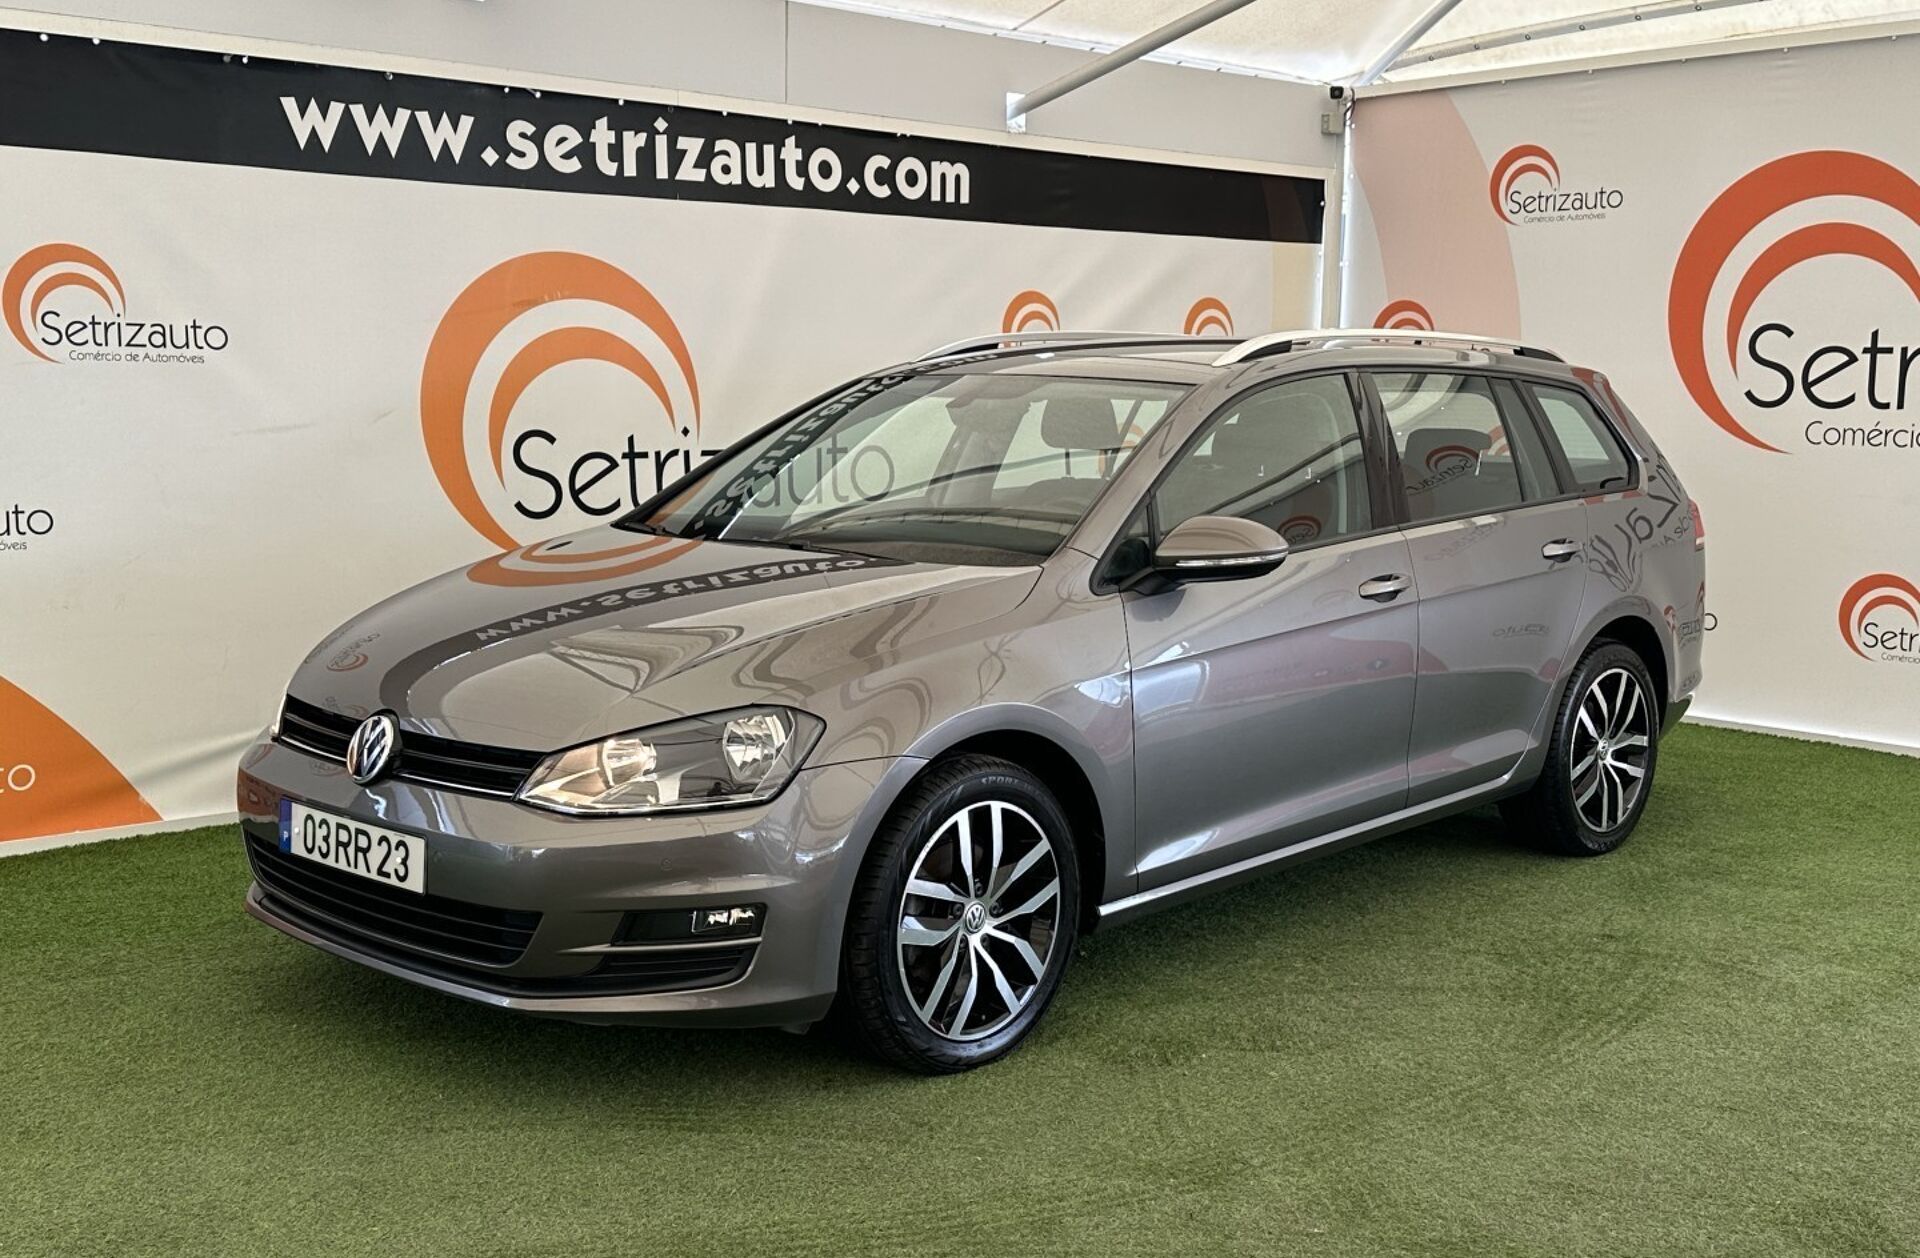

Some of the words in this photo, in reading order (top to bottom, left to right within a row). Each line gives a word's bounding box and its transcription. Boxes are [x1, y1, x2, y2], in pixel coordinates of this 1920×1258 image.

[279, 96, 970, 204] www.setrizauto.com
[1508, 187, 1624, 215] Setrizauto
[40, 310, 229, 351] Setrizauto
[68, 349, 122, 362] Comércio
[124, 351, 140, 362] de
[142, 352, 205, 364] Automóveis
[1804, 420, 1920, 448] Comérci
